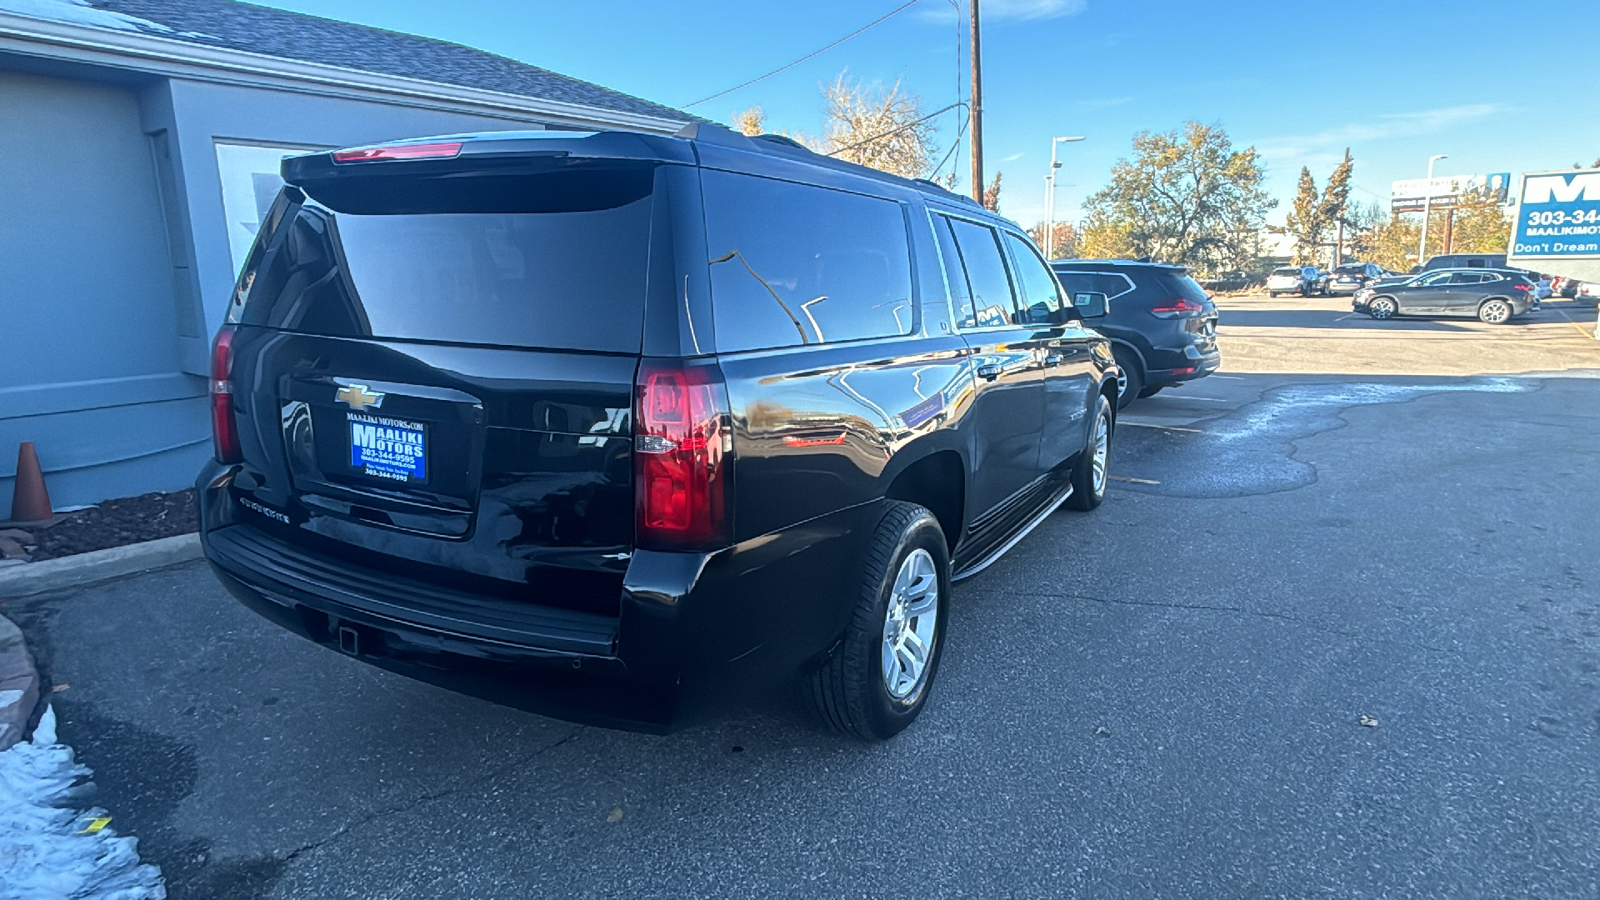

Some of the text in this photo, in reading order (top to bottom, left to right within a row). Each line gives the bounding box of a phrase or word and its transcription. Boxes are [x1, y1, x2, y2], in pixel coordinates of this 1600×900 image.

[1528, 209, 1600, 226] 303-34
[1515, 242, 1598, 252] Don't Dream
[361, 448, 415, 464] 303-344-9595
